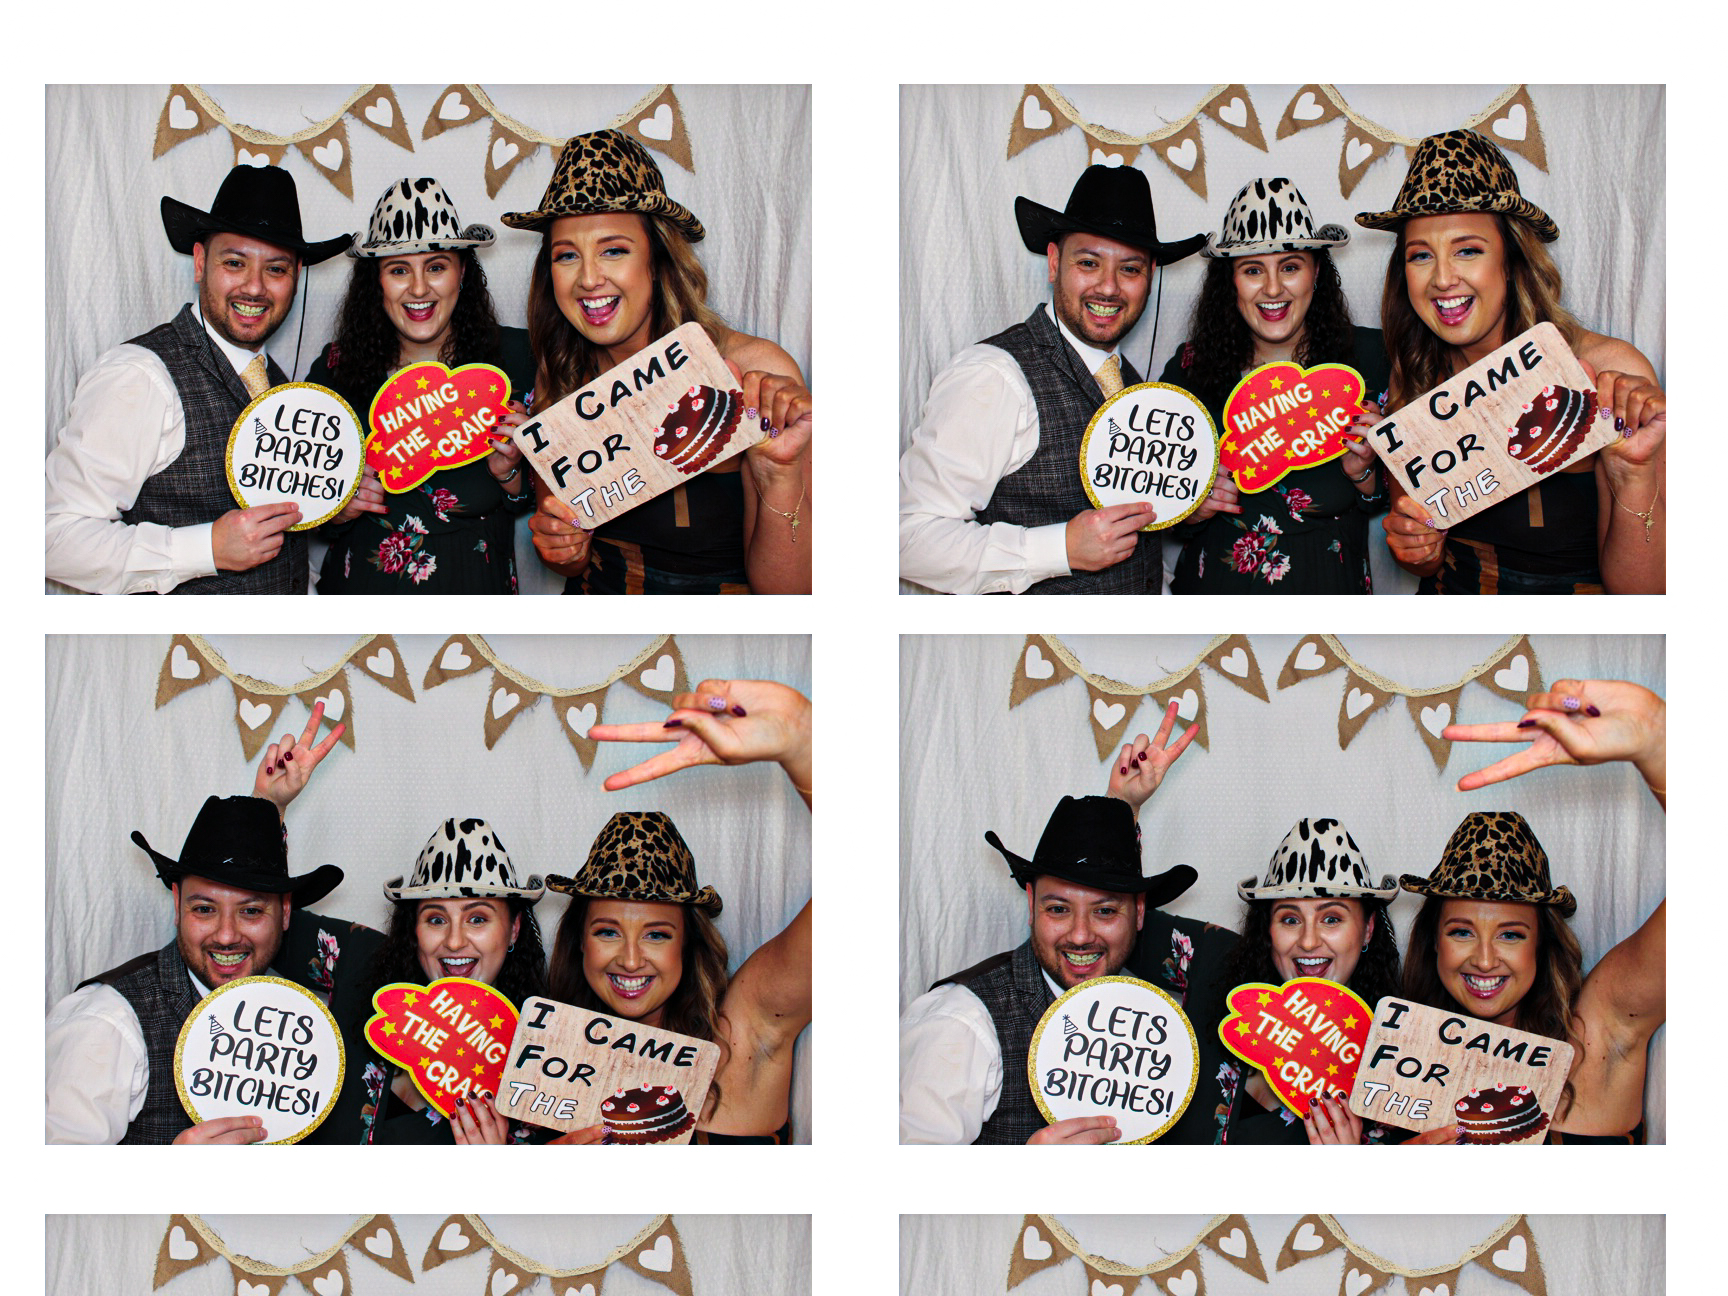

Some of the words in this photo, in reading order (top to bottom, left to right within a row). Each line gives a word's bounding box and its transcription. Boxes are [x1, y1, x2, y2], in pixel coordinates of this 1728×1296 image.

[378, 383, 459, 434] HAVING
[522, 421, 550, 453] I
[575, 341, 689, 420] CAME
[1232, 383, 1313, 434] HAVING
[1376, 421, 1404, 453] I
[1429, 341, 1543, 420] CAME
[274, 404, 341, 441] LETS
[385, 426, 431, 464] THE
[437, 407, 496, 457] CRAIC
[1128, 404, 1195, 441] LETS
[1239, 426, 1285, 464] THE
[1291, 407, 1350, 457] CRAIC
[255, 433, 343, 471] PARTY
[551, 434, 631, 488] FOR
[1109, 433, 1197, 471] PARTY
[1405, 434, 1485, 488] FOR
[239, 463, 345, 502] BITCHES!
[570, 468, 647, 517] THE
[1093, 463, 1199, 502] BITCHES!
[1424, 468, 1501, 517] THE
[233, 1000, 314, 1045] LETS
[402, 1010, 450, 1053] THE
[429, 989, 507, 1064] HAVING
[527, 1001, 556, 1030] I
[584, 1017, 698, 1067] CAME
[1087, 1000, 1168, 1045] LETS
[1256, 1010, 1304, 1053] THE
[1283, 989, 1361, 1064] HAVING
[1381, 1001, 1410, 1030] I
[1438, 1017, 1552, 1067] CAME
[209, 1032, 318, 1080] PARTY
[515, 1044, 596, 1087] FOR
[1063, 1032, 1172, 1080] PARTY
[1369, 1044, 1450, 1087] FOR
[190, 1067, 320, 1118] BITCHES!
[509, 1081, 579, 1120] THE
[1044, 1067, 1174, 1118] BITCHES!
[1363, 1081, 1433, 1120] THE
